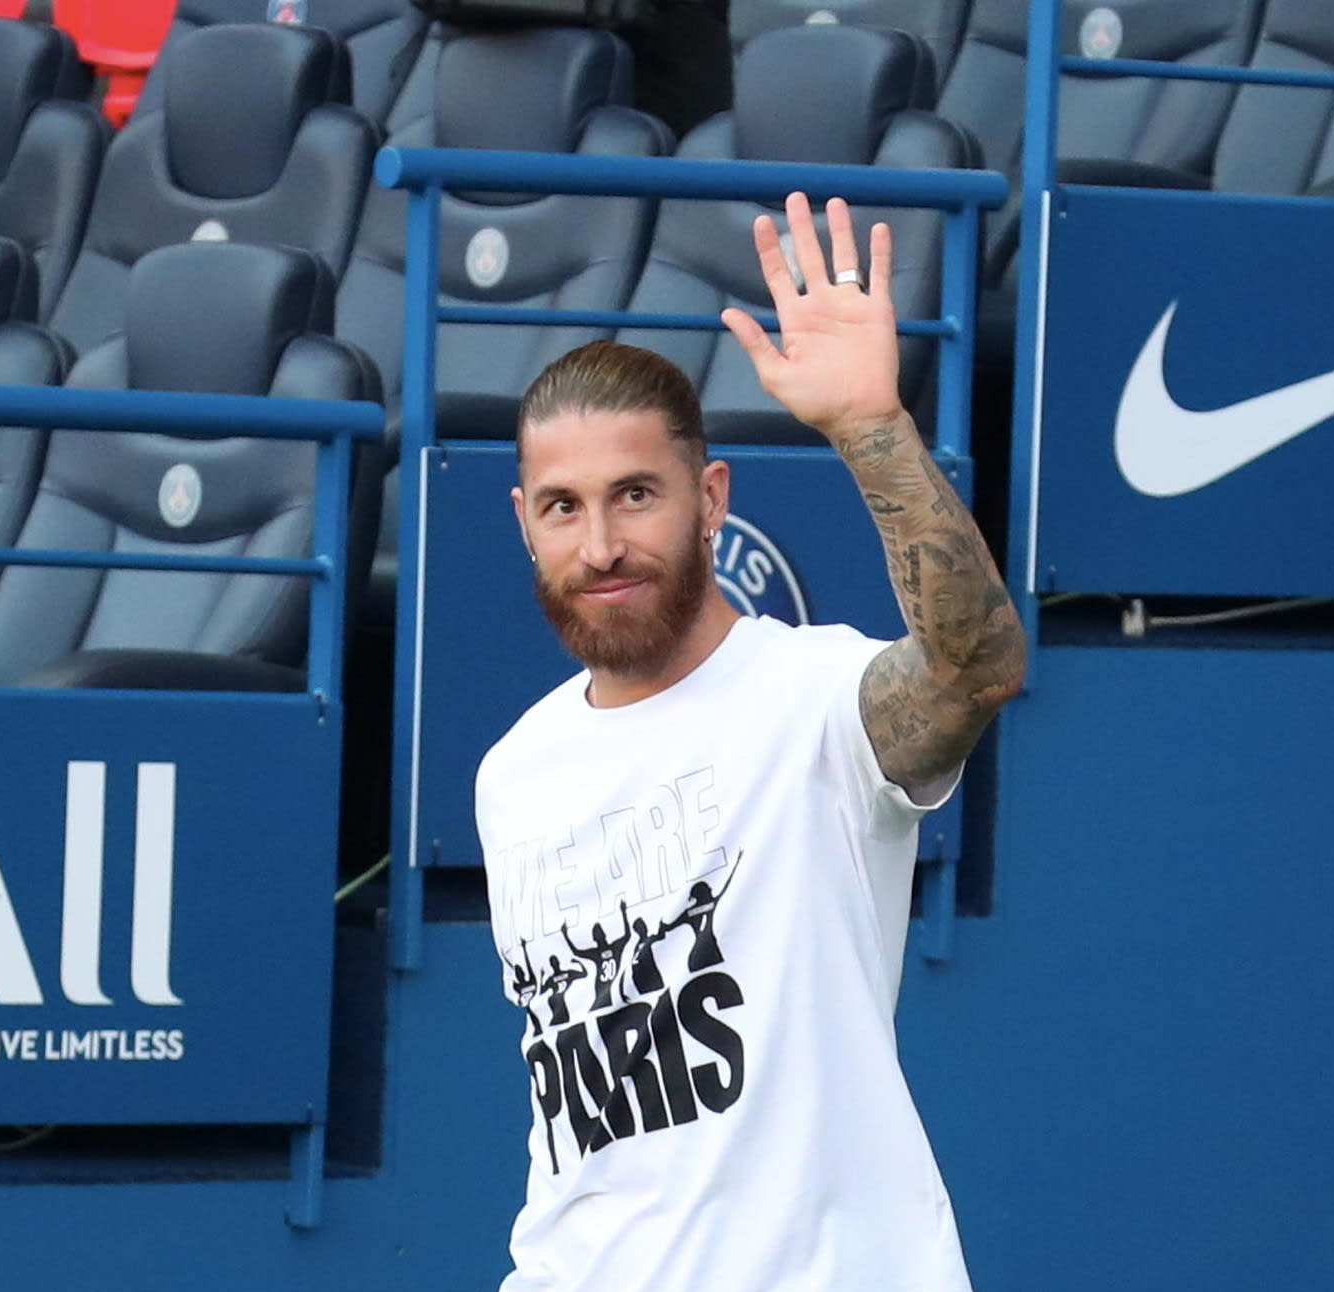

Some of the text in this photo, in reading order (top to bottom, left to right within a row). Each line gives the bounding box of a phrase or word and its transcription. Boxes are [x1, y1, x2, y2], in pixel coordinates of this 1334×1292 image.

[592, 765, 729, 918] ARE
[45, 1030, 184, 1060] LIMITLESS
[525, 972, 745, 1175] PARIS
